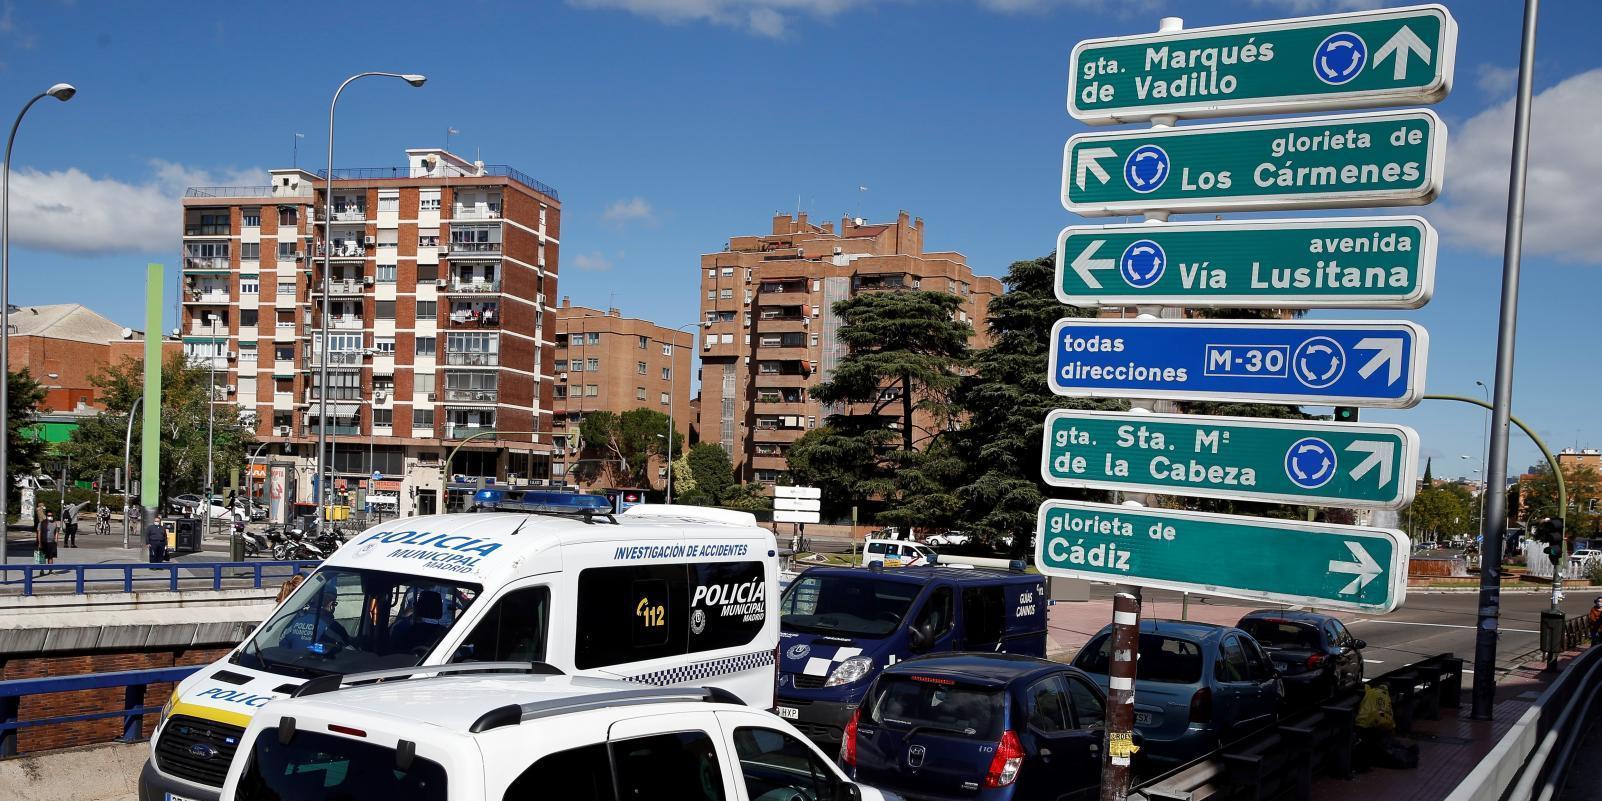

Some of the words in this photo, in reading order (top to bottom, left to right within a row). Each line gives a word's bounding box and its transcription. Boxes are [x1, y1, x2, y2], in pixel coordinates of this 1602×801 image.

[1084, 56, 1126, 79] gta.
[1145, 38, 1275, 74] Marqués
[1081, 81, 1115, 103] de
[1135, 71, 1237, 100] Vadillo
[1271, 129, 1371, 157] glorieta
[1390, 126, 1423, 146] de
[1181, 167, 1232, 191] Los
[1253, 161, 1420, 188] Cármenes
[1310, 232, 1412, 253] avenida
[1179, 261, 1227, 289] Vía
[1251, 260, 1409, 289] Lusitana
[1064, 334, 1125, 353] todas
[1209, 349, 1285, 372] M-30
[1061, 361, 1188, 382] direcciones
[1055, 427, 1097, 447] gta.
[1116, 425, 1175, 451] Sta.
[1054, 452, 1087, 474] de
[1105, 453, 1129, 478] la
[1150, 456, 1257, 487] Cabeza
[1050, 515, 1134, 537] glorieta
[1148, 522, 1176, 541] de
[357, 531, 503, 557] POLICÍA
[614, 543, 686, 560] INVESTIGACIÓN
[686, 545, 699, 557] DE
[699, 544, 748, 556] ACCIDENTES
[1047, 536, 1131, 570] Cádiz
[387, 549, 482, 567] MUNICIPAL
[423, 561, 473, 574] MADRID
[691, 576, 765, 607] POLICÍA
[643, 605, 665, 627] 112
[720, 602, 765, 617] MUNICIPAL
[743, 613, 764, 622] MADRID
[782, 708, 797, 718] HXP
